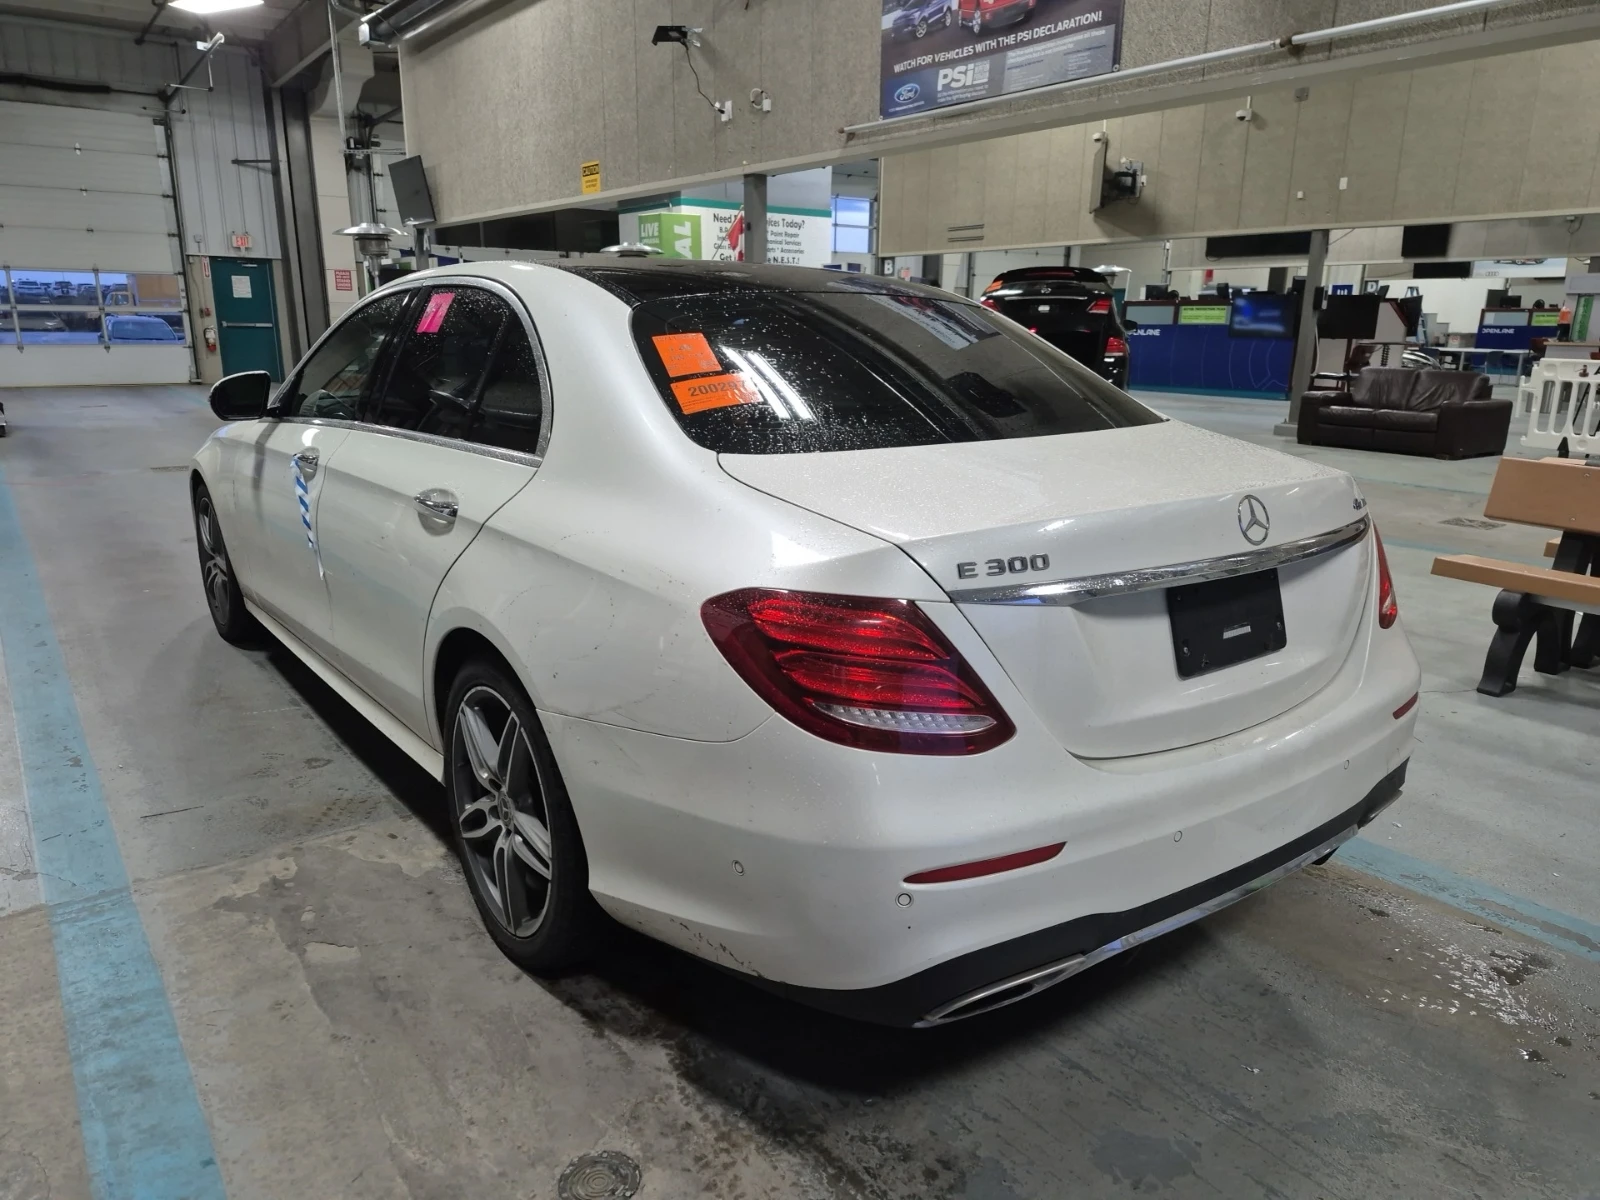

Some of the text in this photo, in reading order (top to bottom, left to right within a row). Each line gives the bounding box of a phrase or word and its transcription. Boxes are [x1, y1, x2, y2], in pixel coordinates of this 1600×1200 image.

[893, 59, 917, 74] WATCH
[916, 54, 933, 66] FOR
[934, 45, 975, 62] VEHICLES
[974, 39, 998, 54] WITH
[997, 35, 1016, 49] THE
[1016, 30, 1033, 43] PSI
[1032, 10, 1103, 40] DECLARATION!
[712, 212, 732, 224] Need
[781, 217, 805, 231] Today?
[640, 222, 660, 237] LIVE
[784, 231, 800, 239] Repair
[784, 238, 802, 246] Services
[719, 252, 732, 261] Get
[884, 260, 893, 275] B
[1367, 281, 1377, 293] D
[957, 552, 1051, 580] E 300
